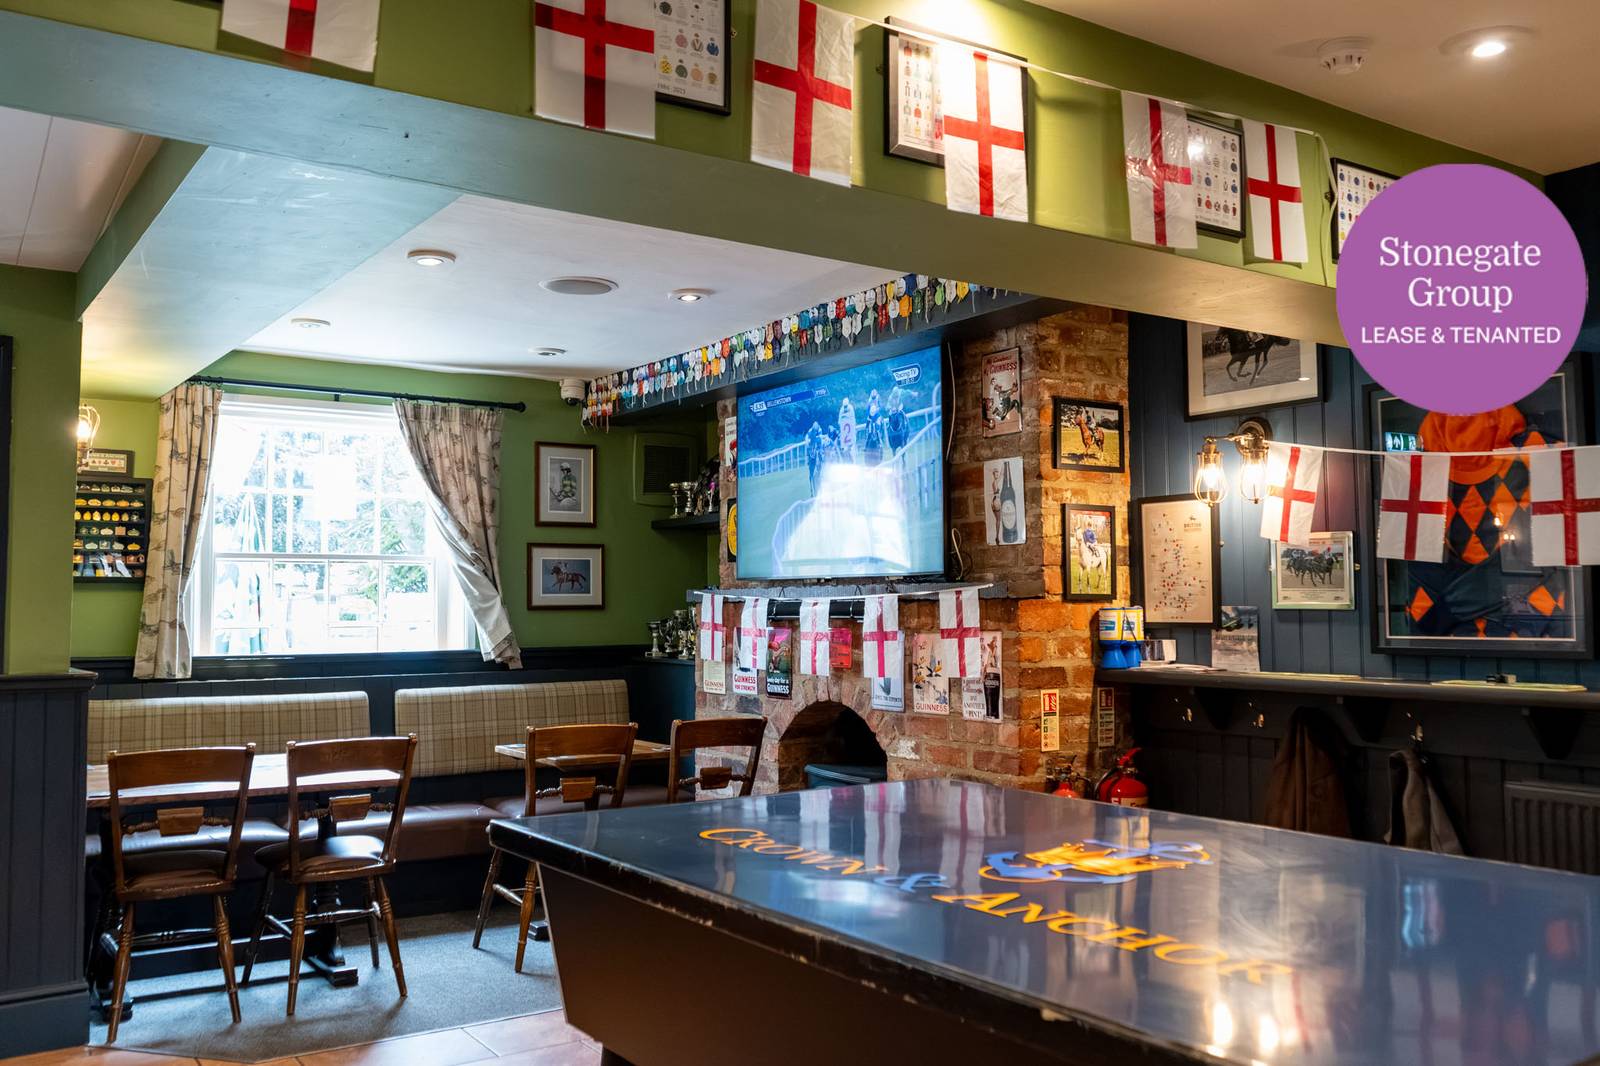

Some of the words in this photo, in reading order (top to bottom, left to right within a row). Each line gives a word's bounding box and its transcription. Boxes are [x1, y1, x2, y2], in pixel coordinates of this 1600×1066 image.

[734, 673, 756, 685] GUINNESS
[767, 683, 790, 694] GUINNESS
[915, 703, 948, 713] GUINNESS
[699, 828, 889, 875] CROWN
[932, 892, 1293, 985] ANCHOR
